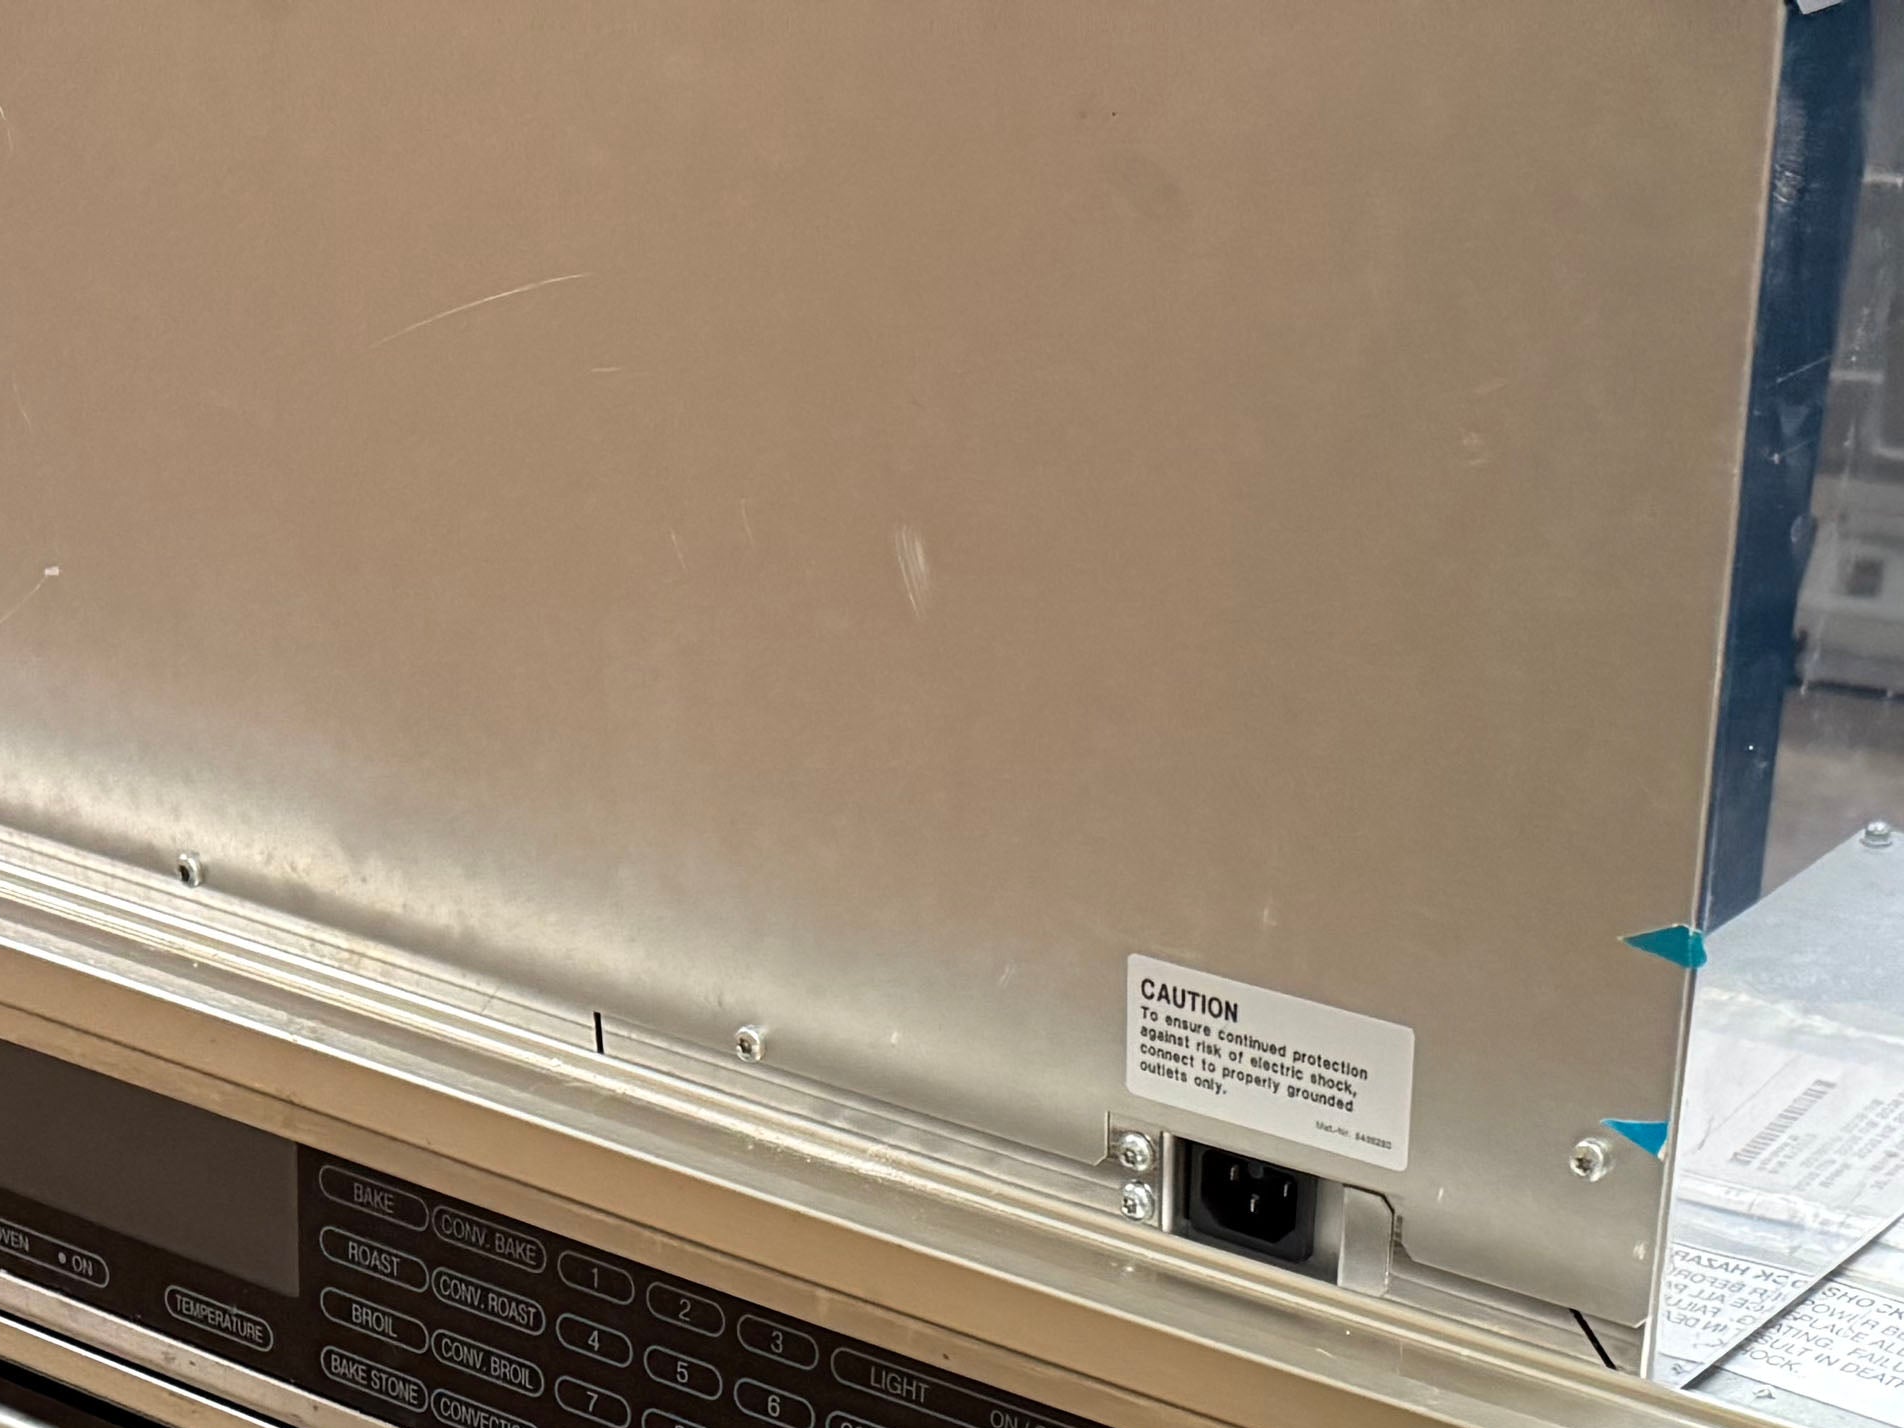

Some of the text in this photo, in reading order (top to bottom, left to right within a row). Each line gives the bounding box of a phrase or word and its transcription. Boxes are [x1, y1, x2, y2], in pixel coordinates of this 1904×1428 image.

[1141, 978, 1239, 1023] CAUTION
[1141, 1006, 1368, 1081] To ensure continued protection
[1140, 1026, 1357, 1098] against risk of electric shock,
[1140, 1044, 1354, 1112] connect to properly grounded
[1140, 1061, 1227, 1096] outlets only.
[353, 1182, 393, 1214] BAKE
[441, 1214, 537, 1265] CONV. BAKE
[72, 1255, 93, 1277] ON
[348, 1241, 400, 1277] ROAST
[592, 1268, 599, 1288] 1
[175, 1294, 263, 1344] TEMPERATURE
[440, 1275, 536, 1328] CONV. ROAST
[679, 1300, 691, 1321] 2
[1822, 1286, 1904, 1321] SHOCK
[352, 1304, 397, 1337] BROIL
[588, 1330, 599, 1351] 4
[771, 1331, 783, 1354] 3
[441, 1337, 534, 1389] CONV. BROIL
[677, 1362, 688, 1383] 5
[1815, 1353, 1838, 1366] IN
[331, 1355, 418, 1405] BAKE STONE
[871, 1367, 929, 1403] LIGHT
[587, 1393, 598, 1413] 7
[768, 1395, 780, 1417] 6
